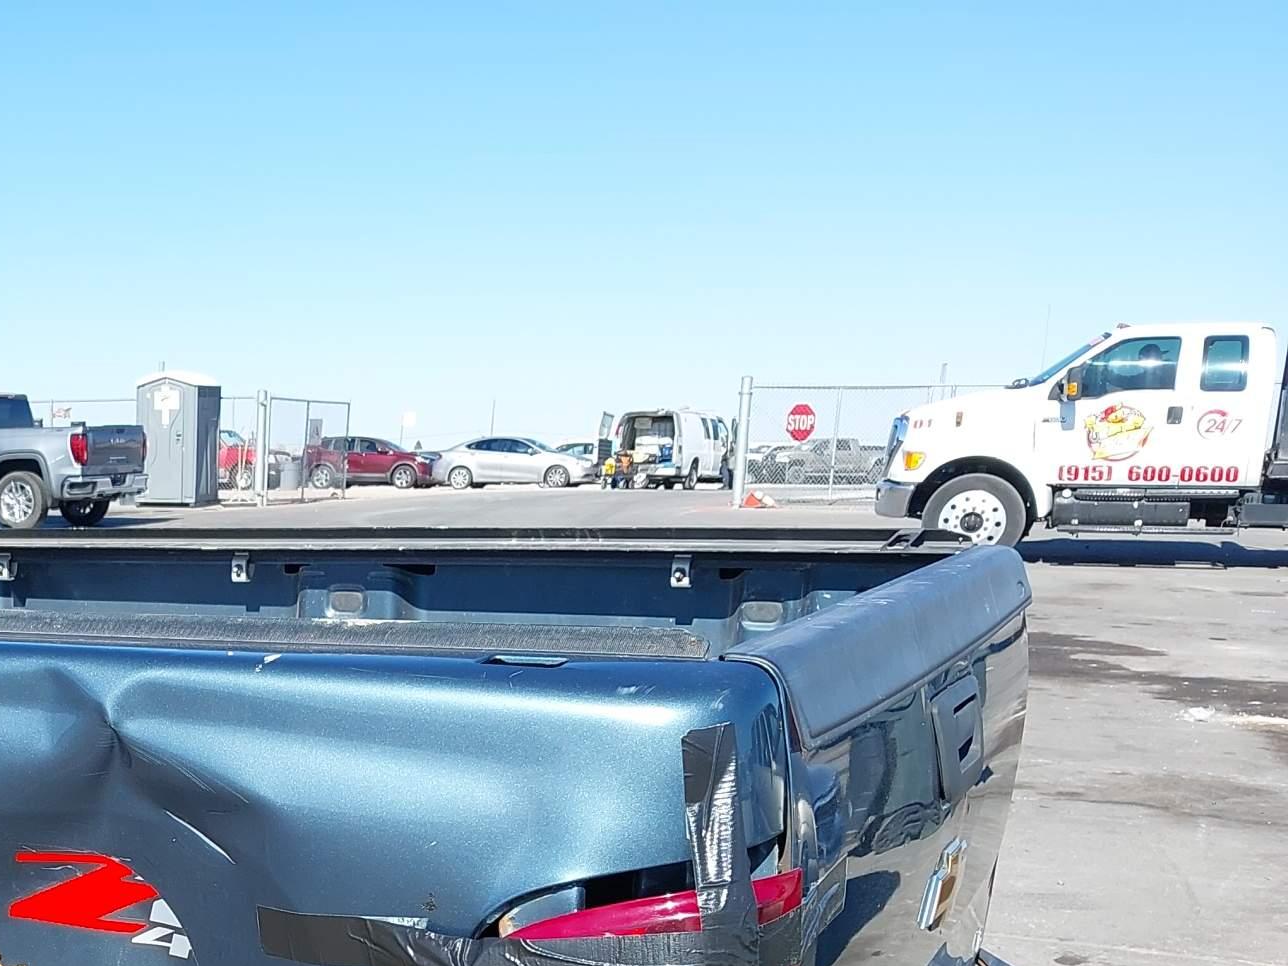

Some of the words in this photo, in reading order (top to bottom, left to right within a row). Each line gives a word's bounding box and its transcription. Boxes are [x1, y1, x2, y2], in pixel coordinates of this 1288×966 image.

[787, 413, 815, 432] STOP
[1204, 418, 1243, 434] 24/7
[1058, 464, 1113, 482] (915)
[1127, 464, 1239, 483] 600-0600
